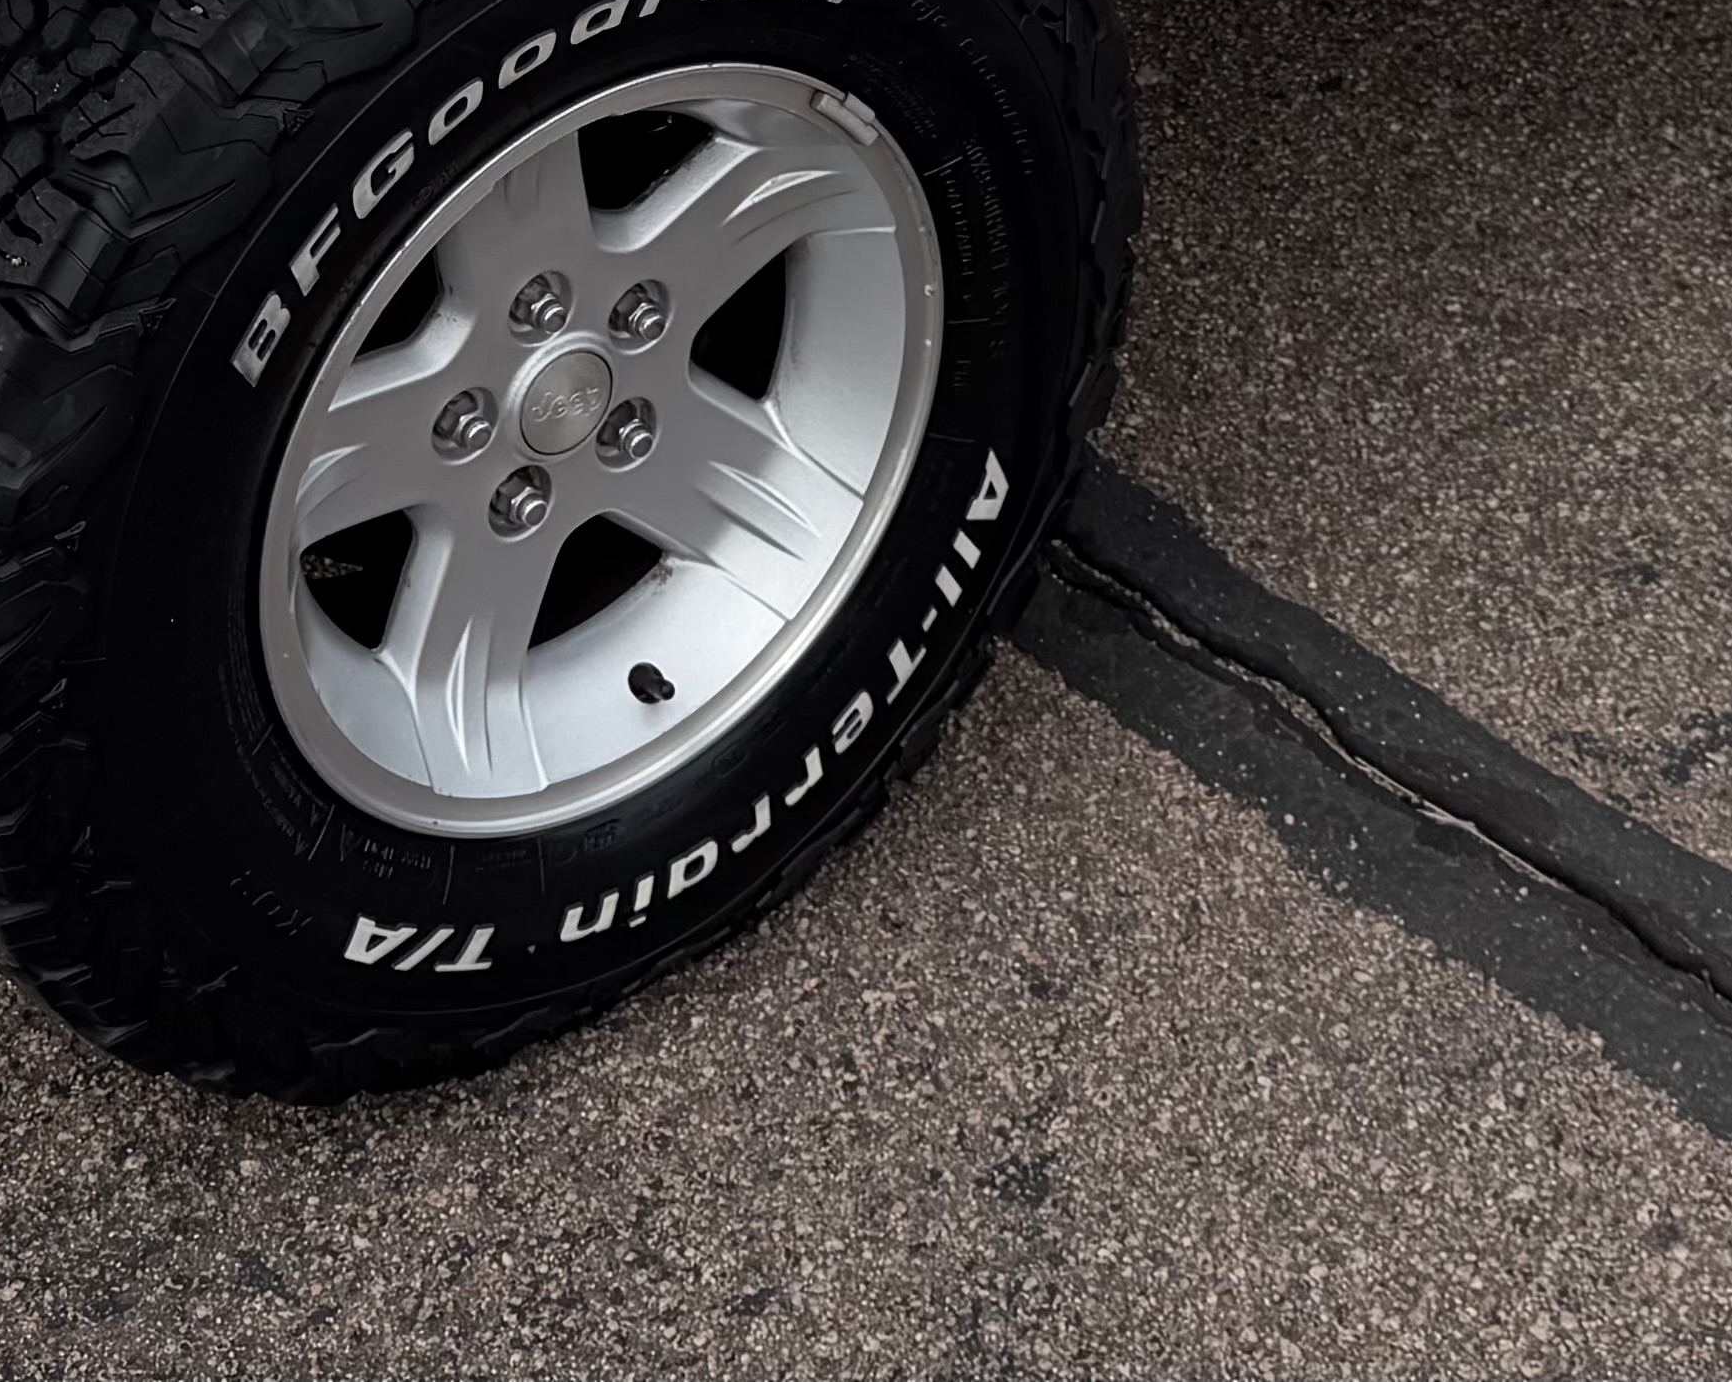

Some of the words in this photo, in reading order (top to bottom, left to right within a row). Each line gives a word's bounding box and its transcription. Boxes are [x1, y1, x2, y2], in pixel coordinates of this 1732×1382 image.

[532, 387, 601, 422] Jeep
[558, 449, 1005, 948] All-Terrain
[343, 916, 495, 973] T/A
